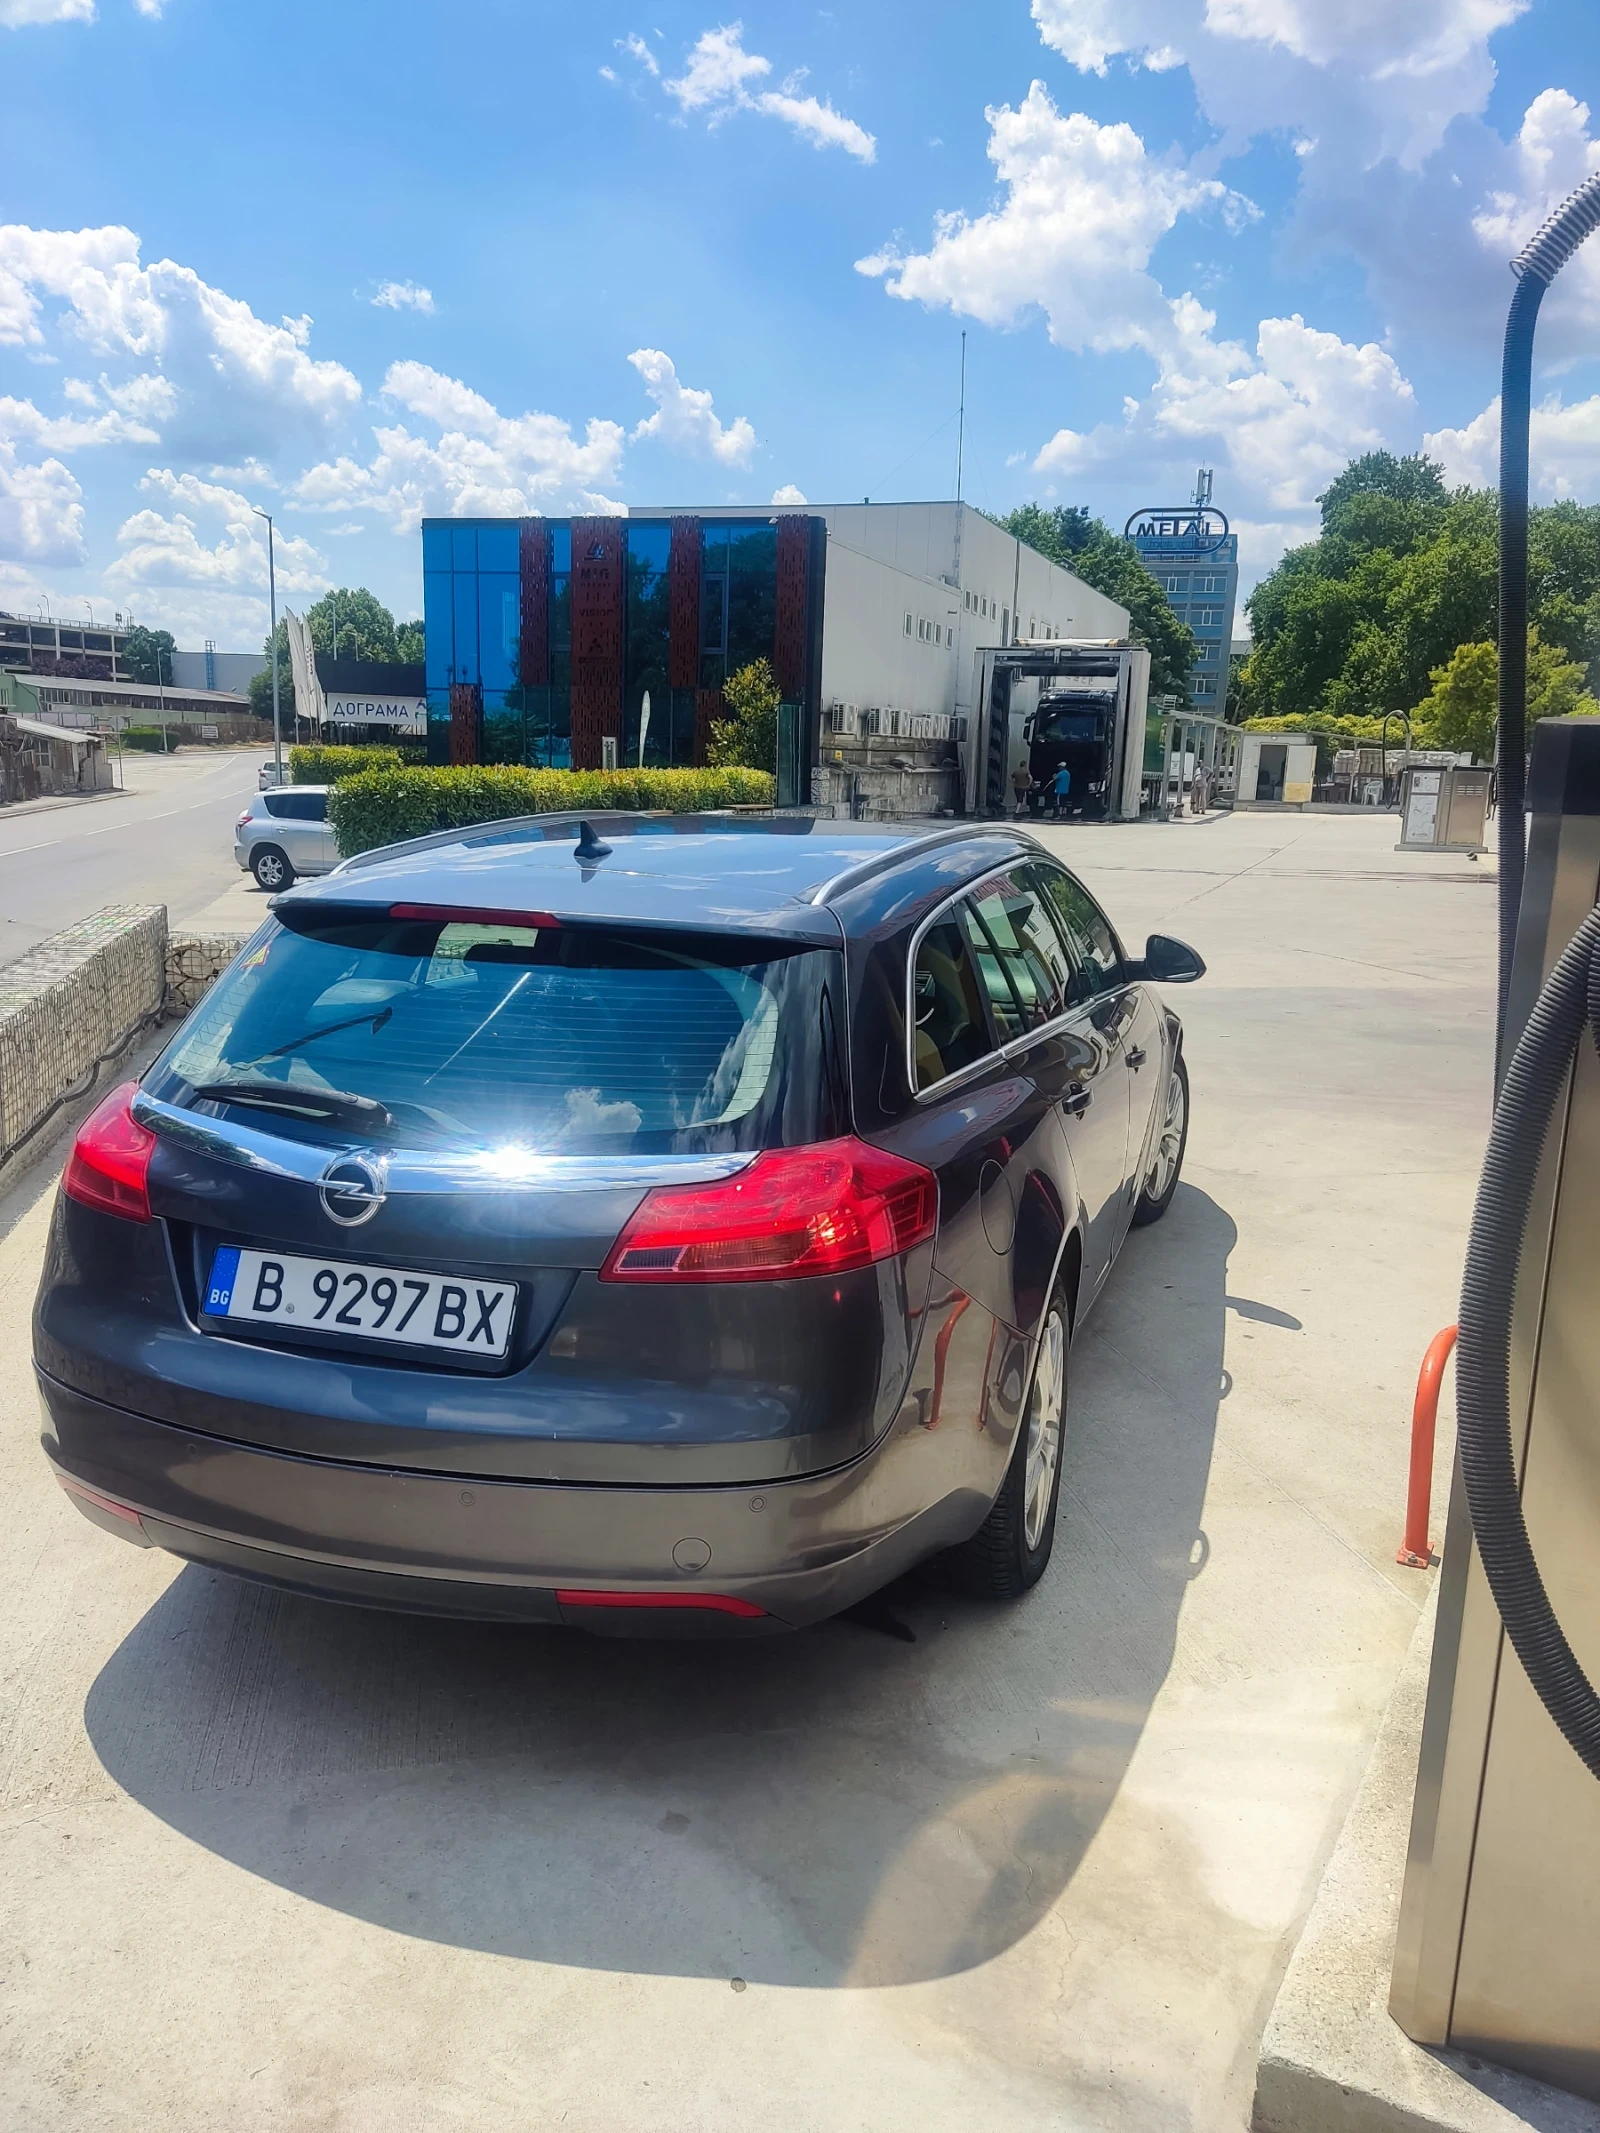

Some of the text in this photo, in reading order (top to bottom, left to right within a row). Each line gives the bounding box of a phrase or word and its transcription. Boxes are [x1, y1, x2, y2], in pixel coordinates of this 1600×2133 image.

[1136, 516, 1219, 537] METAL
[333, 701, 409, 718] ДОГРАМА
[209, 1289, 229, 1306] BG
[252, 1262, 504, 1345] B 9297 BX
